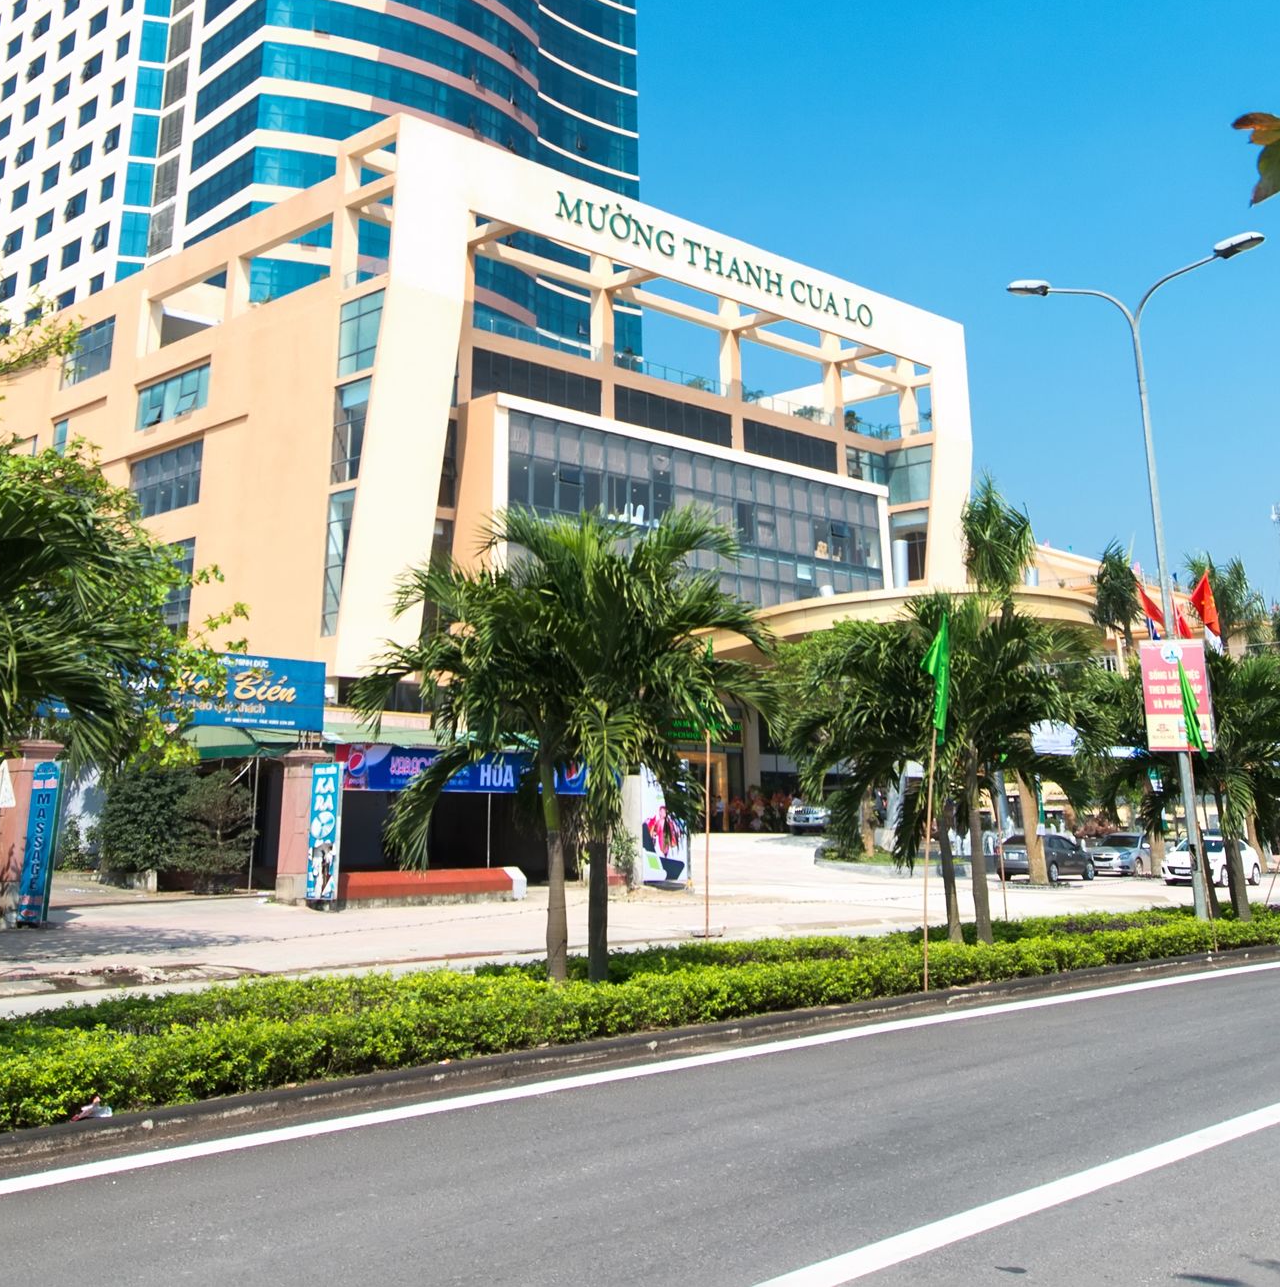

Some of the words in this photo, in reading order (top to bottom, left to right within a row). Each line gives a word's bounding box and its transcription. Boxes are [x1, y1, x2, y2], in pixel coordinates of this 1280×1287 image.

[555, 190, 675, 257] MƯỜNG
[683, 237, 783, 297] THANH
[791, 279, 839, 316] CUA
[844, 297, 873, 328] LO
[29, 793, 51, 891] MASSAGE
